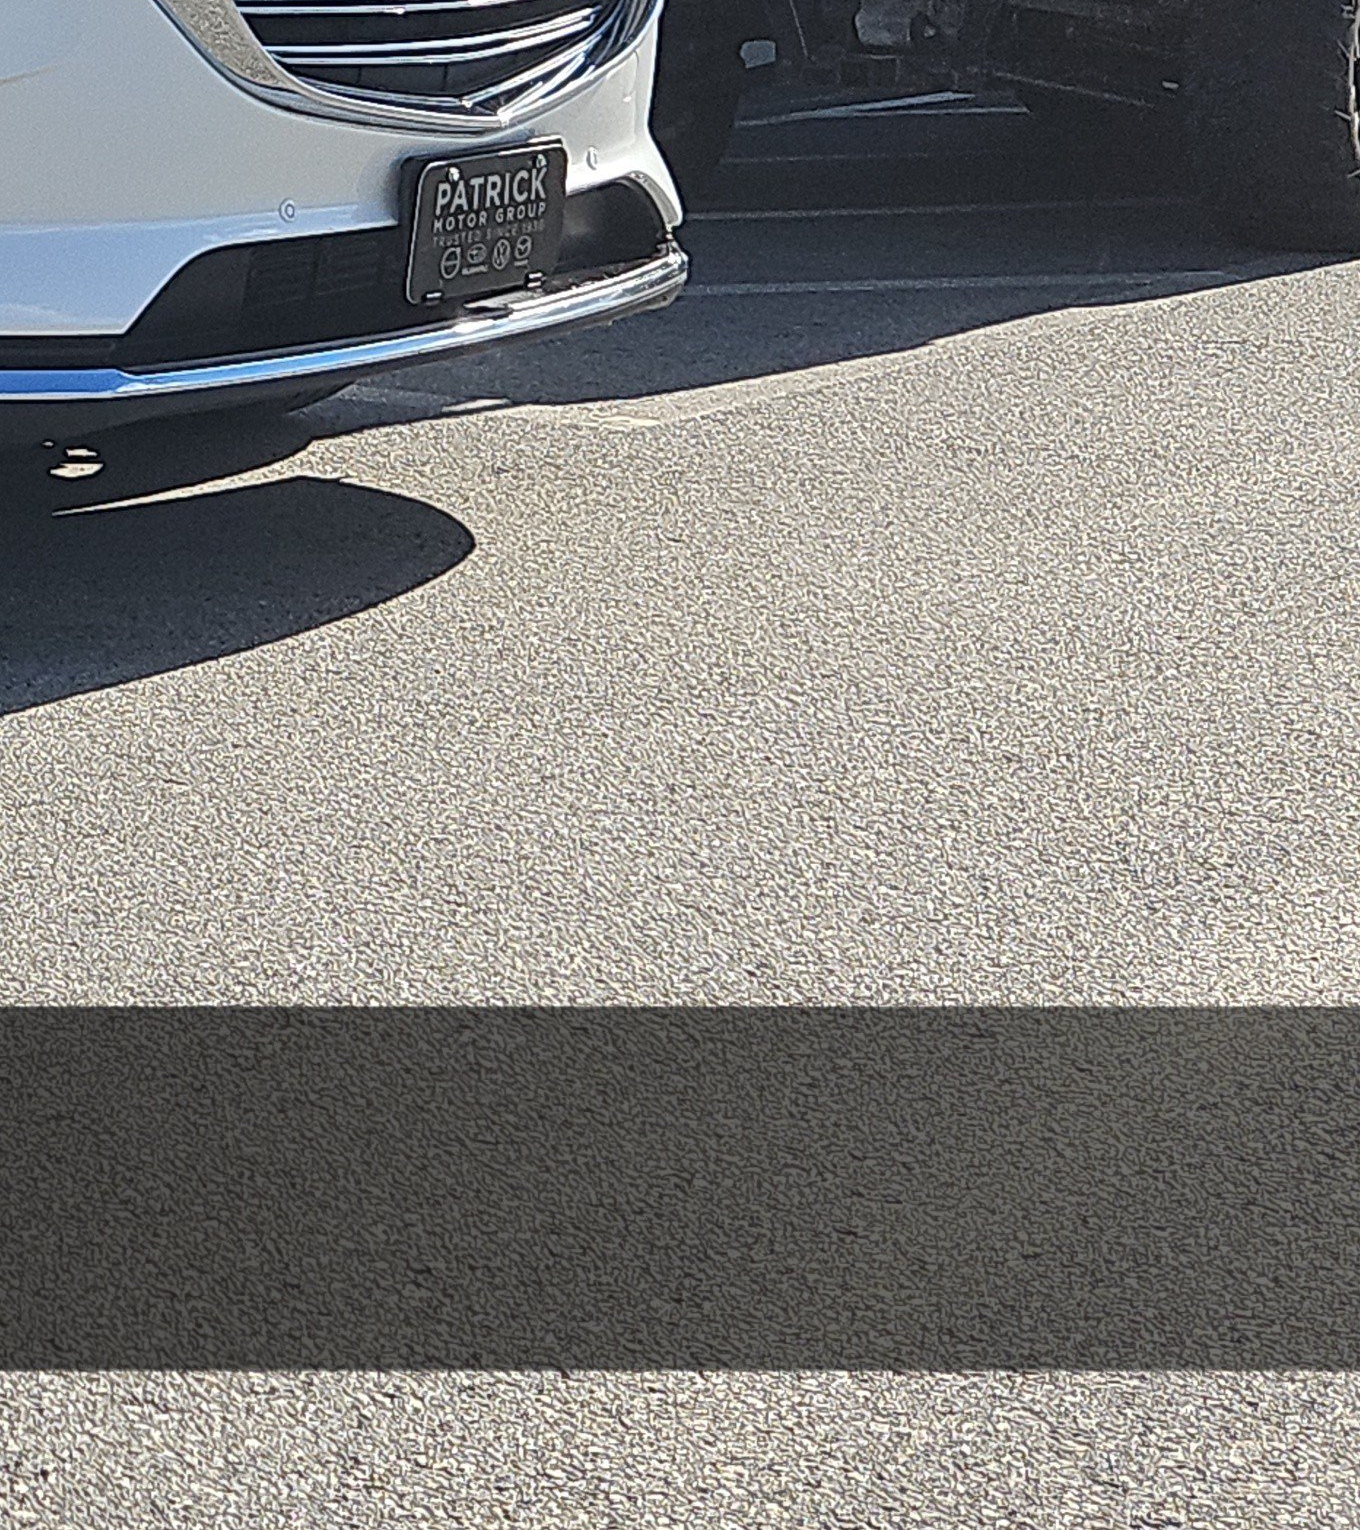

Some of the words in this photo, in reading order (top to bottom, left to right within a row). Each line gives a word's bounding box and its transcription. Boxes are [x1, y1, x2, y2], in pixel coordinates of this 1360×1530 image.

[434, 167, 548, 217] PATRICK
[433, 211, 488, 234] MOTOR
[495, 201, 547, 223] GROUP
[486, 223, 519, 240] SNCE
